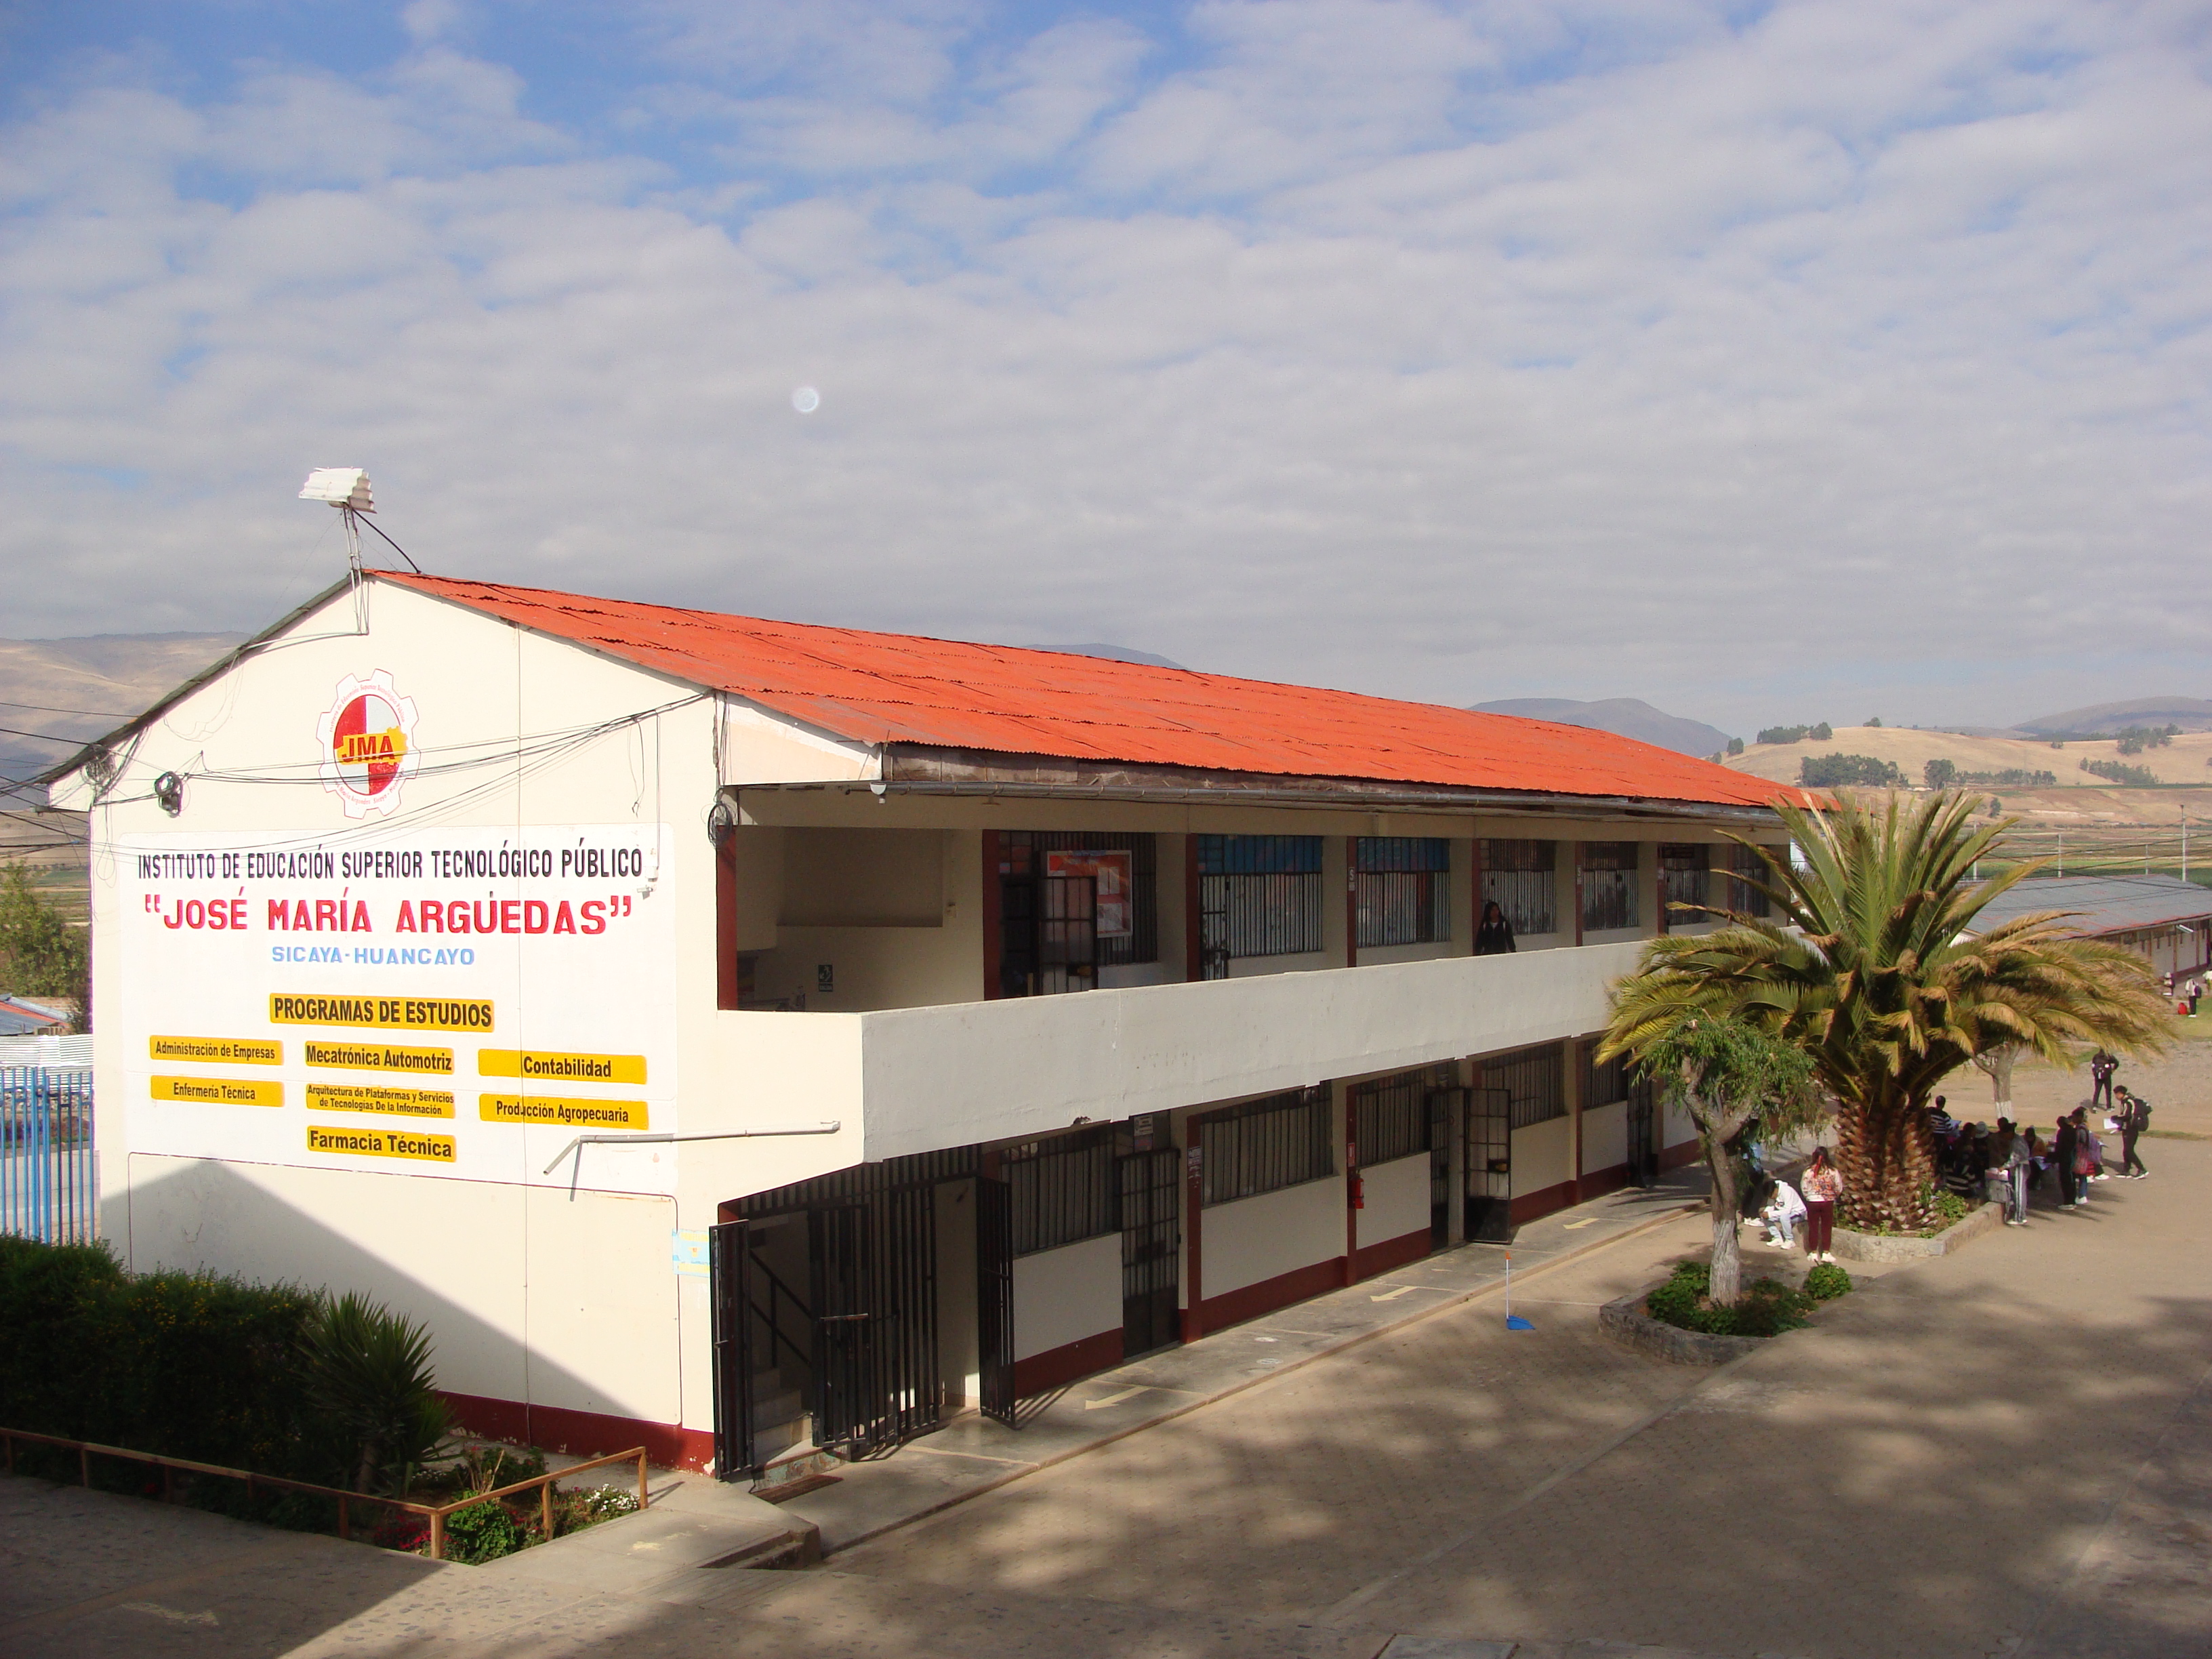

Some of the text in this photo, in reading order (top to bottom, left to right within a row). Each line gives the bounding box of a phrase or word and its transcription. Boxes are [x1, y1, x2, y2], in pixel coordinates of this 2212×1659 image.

[342, 735, 395, 762] JMA
[138, 837, 643, 879] INSTITUTO DE EDUCACIÓN SUPERIOR TECNOLÓGICO PÚBLICO
[268, 886, 373, 933] MARÍA
[274, 998, 492, 1027] PROGRAMAS DE ESTUDIOS
[155, 1041, 275, 1061] Administración de Empresas
[306, 1045, 452, 1071] Mecatrónica Automotriz
[523, 1056, 612, 1078] Contabilidad
[173, 1082, 255, 1100] Enfermería Técnica
[308, 1085, 454, 1103] Arquitectura de Plataformas y Servicios
[319, 1097, 442, 1115] de Tecnologías De la Información
[496, 1100, 629, 1123] Producción Agropecuaria
[310, 1130, 452, 1158] Farmacia Técnica
